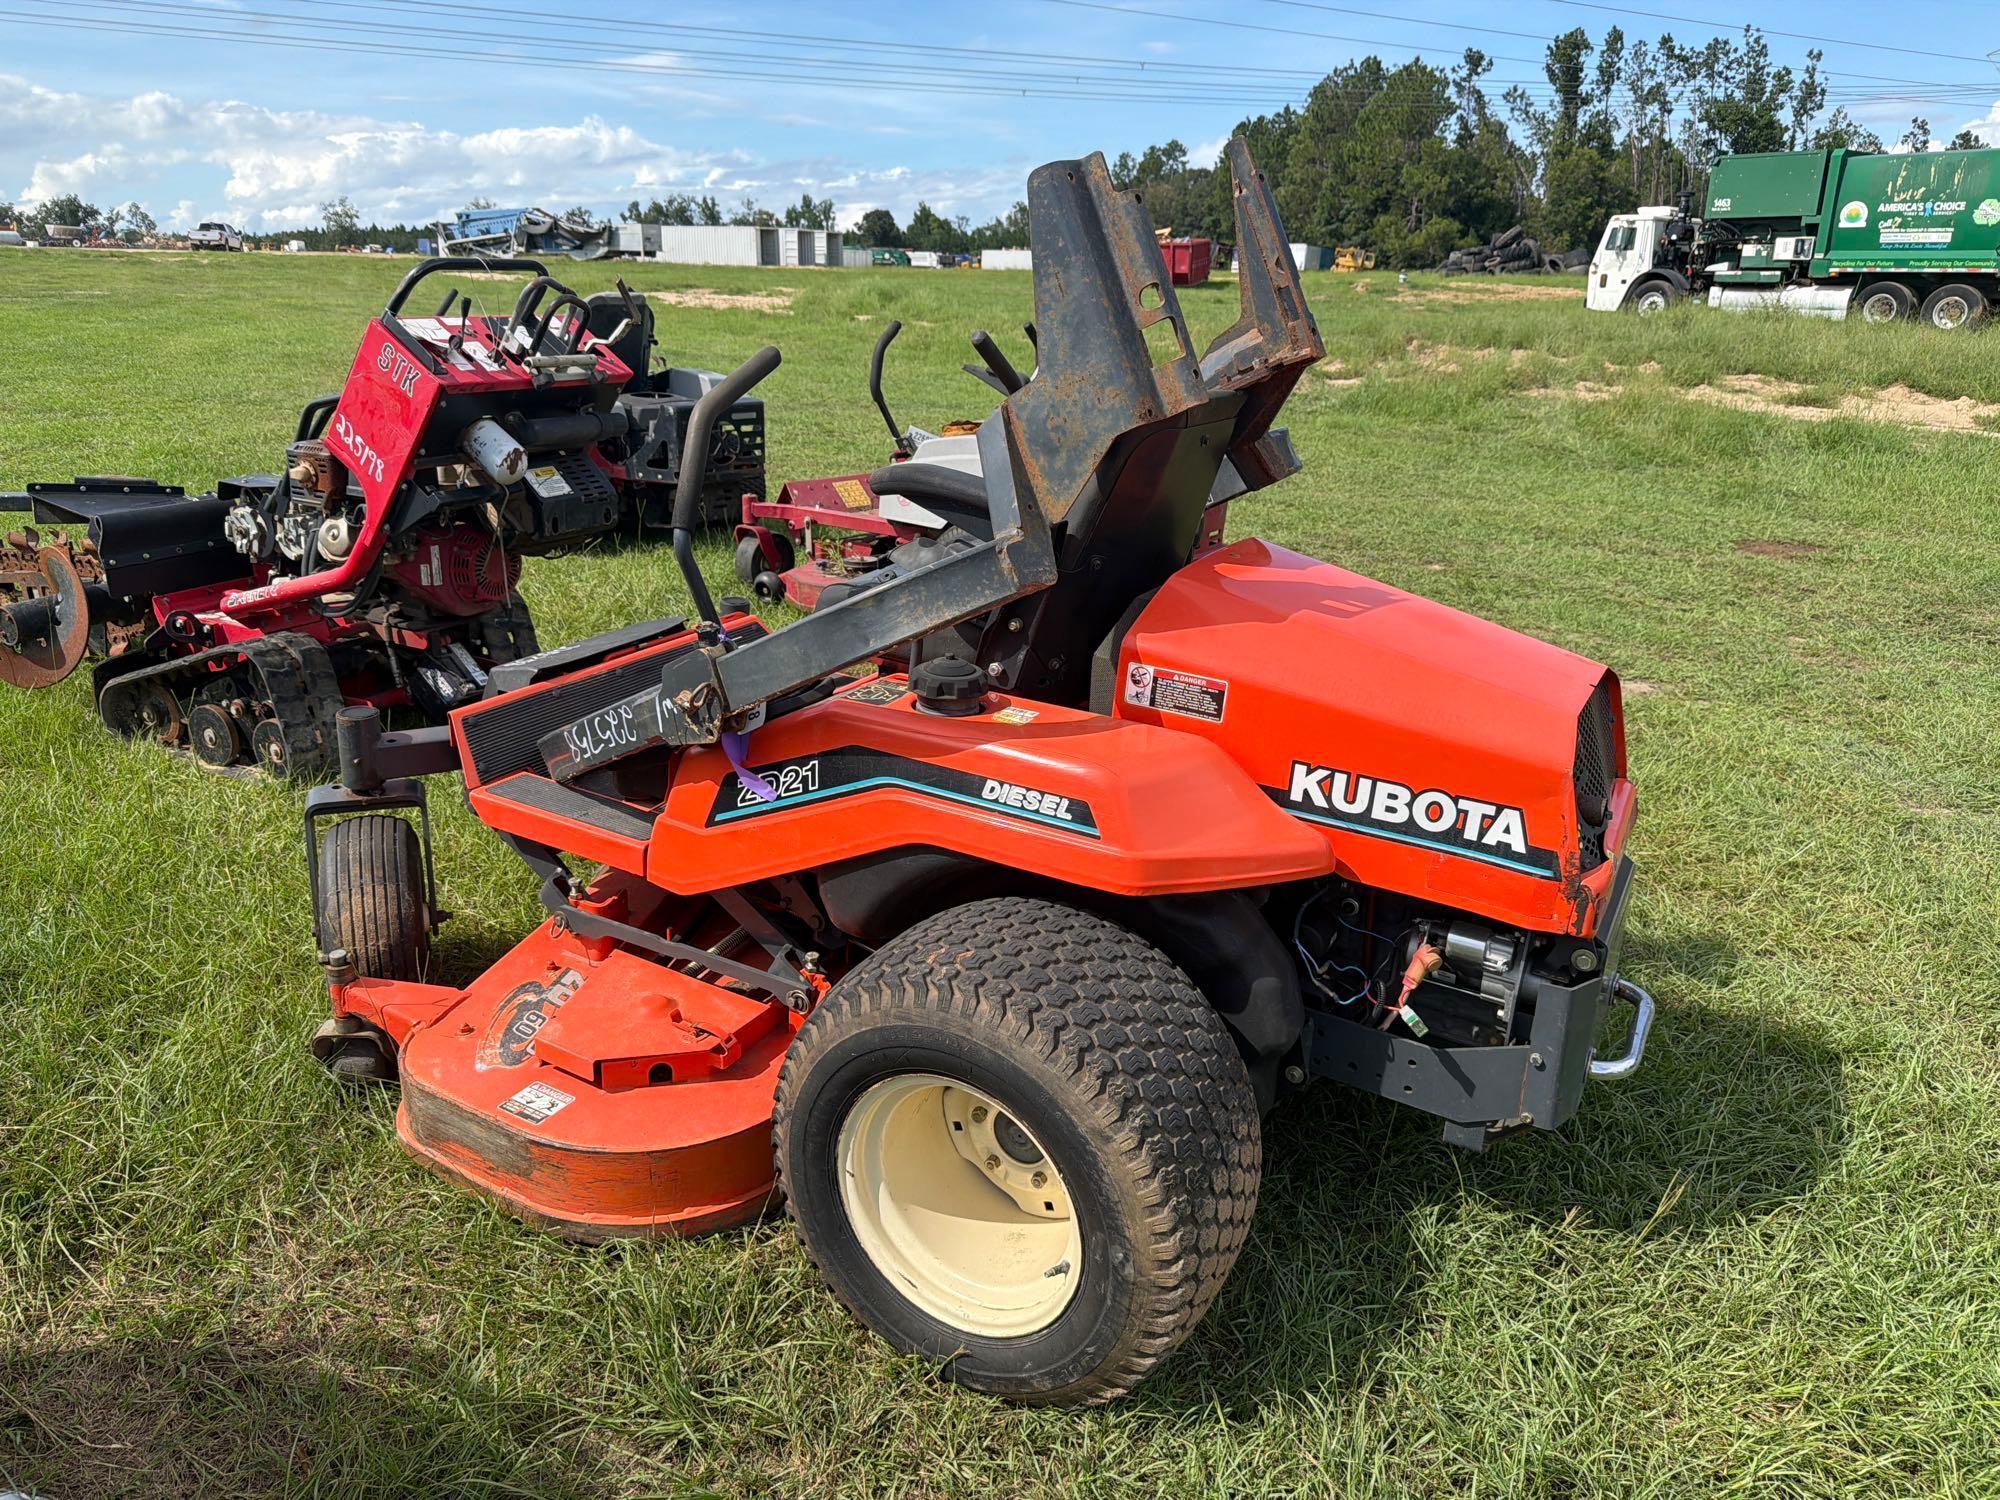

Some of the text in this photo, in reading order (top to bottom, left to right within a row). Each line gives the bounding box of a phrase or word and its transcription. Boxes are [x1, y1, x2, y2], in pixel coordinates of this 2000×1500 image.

[1877, 201, 1967, 212] AMERICA'S CHOICE
[1931, 260, 1952, 268] Serving
[1965, 260, 1997, 268] Community
[377, 342, 421, 398] STK
[335, 413, 385, 483] 225198
[1179, 674, 1207, 686] DANGER
[563, 704, 637, 763] 225758
[981, 778, 1073, 821] DIESEL
[1289, 762, 1527, 855] KUBOTA
[538, 1085, 575, 1103] DANGER
